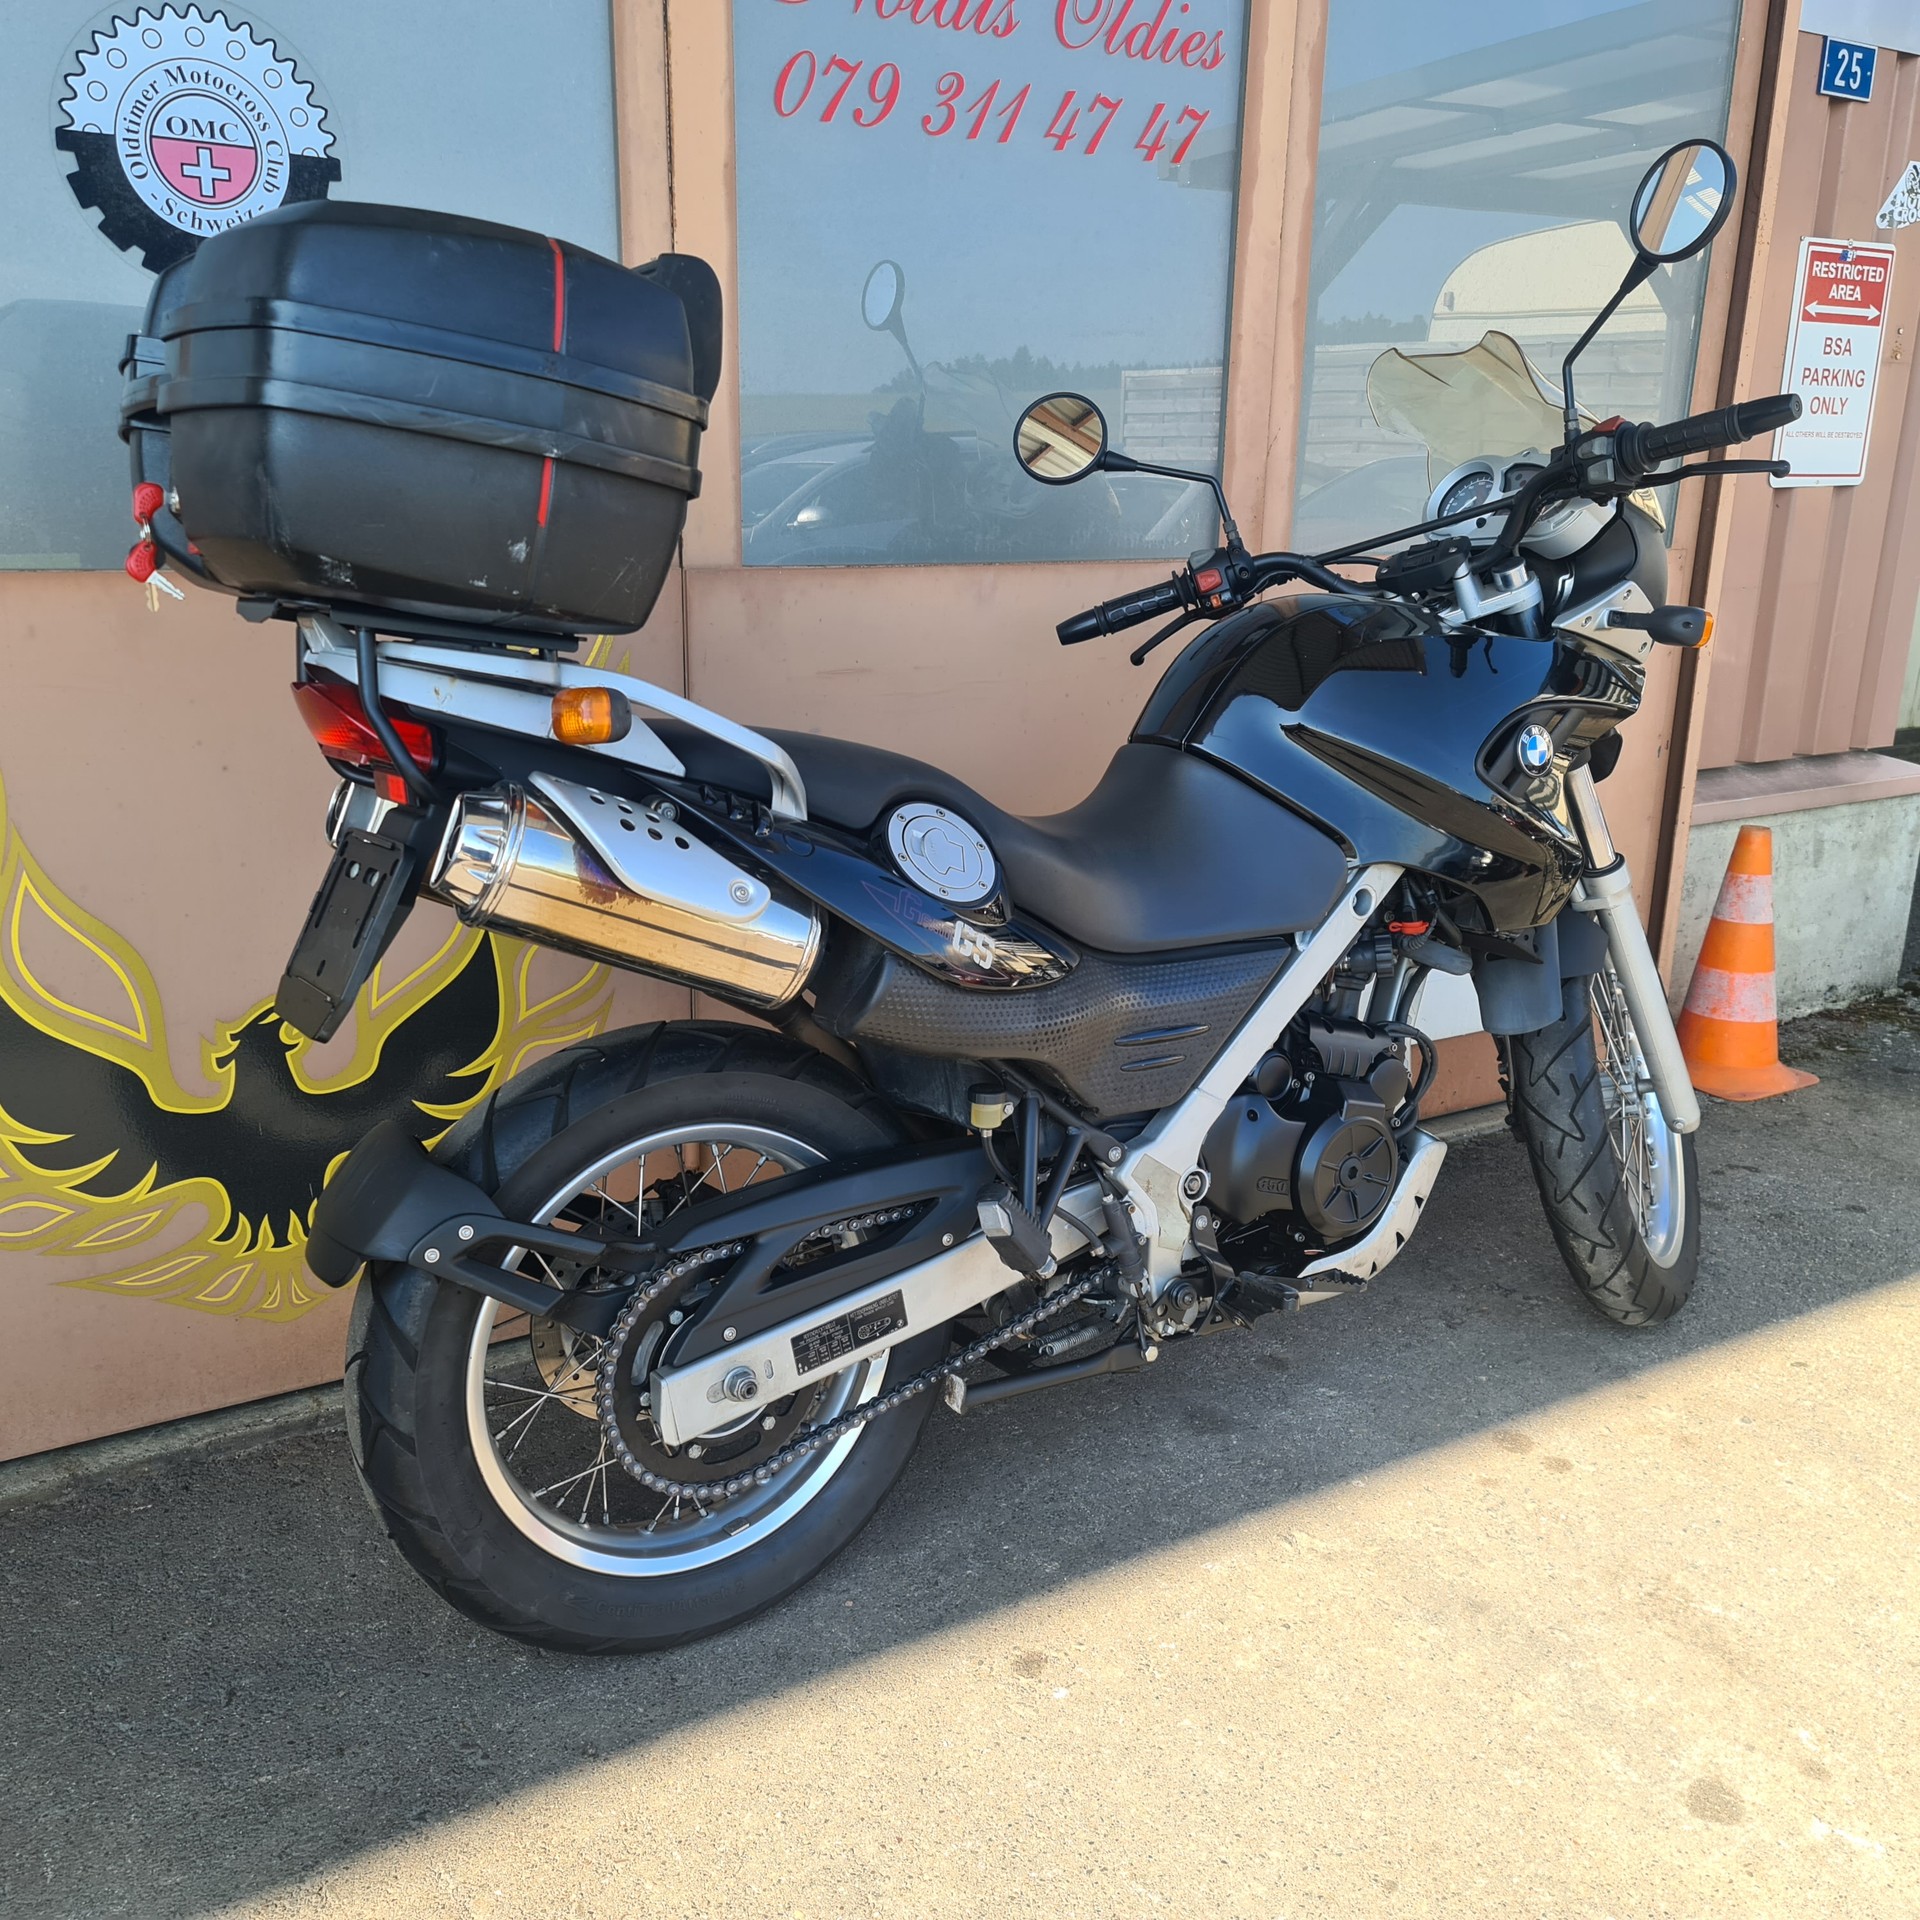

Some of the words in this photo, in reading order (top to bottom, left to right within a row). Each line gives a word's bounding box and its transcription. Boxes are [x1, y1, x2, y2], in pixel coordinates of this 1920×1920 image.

[1054, 0, 1228, 70] Oldies
[1834, 48, 1863, 90] 25
[773, 50, 901, 128] 079
[921, 71, 1032, 143] 311
[1043, 90, 1124, 155] 47
[1134, 102, 1211, 164] 47
[123, 80, 160, 180] Oldtimer
[163, 65, 271, 132] Motocross
[263, 140, 284, 193] Club
[166, 116, 239, 142] OMC
[1812, 261, 1885, 282] RESTRICTED
[1828, 284, 1862, 301] AREA
[1823, 337, 1852, 356] BSA
[1801, 367, 1866, 387] PARKING
[1810, 396, 1848, 415] ONLY
[953, 920, 996, 970] GS
